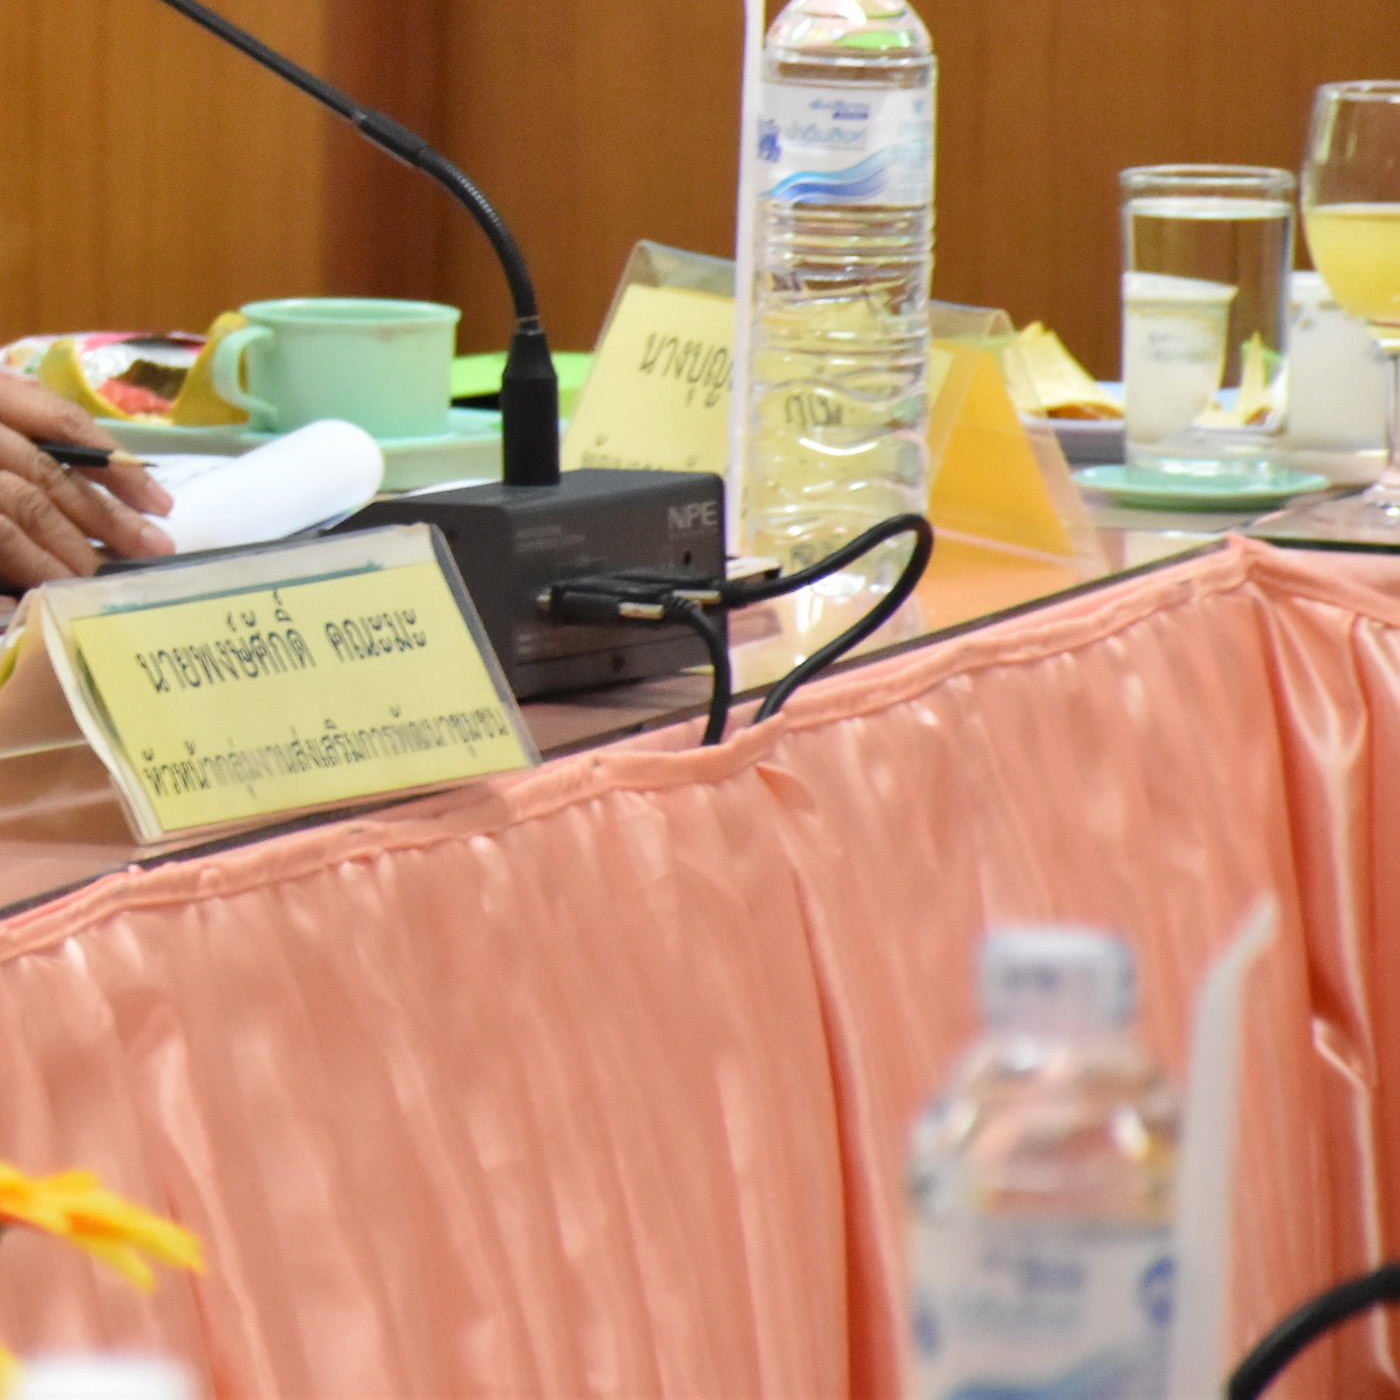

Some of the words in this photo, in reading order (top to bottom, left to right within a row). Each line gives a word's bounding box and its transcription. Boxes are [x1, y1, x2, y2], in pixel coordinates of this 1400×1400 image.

[135, 588, 318, 694] นายพงษ์ศักดิ์
